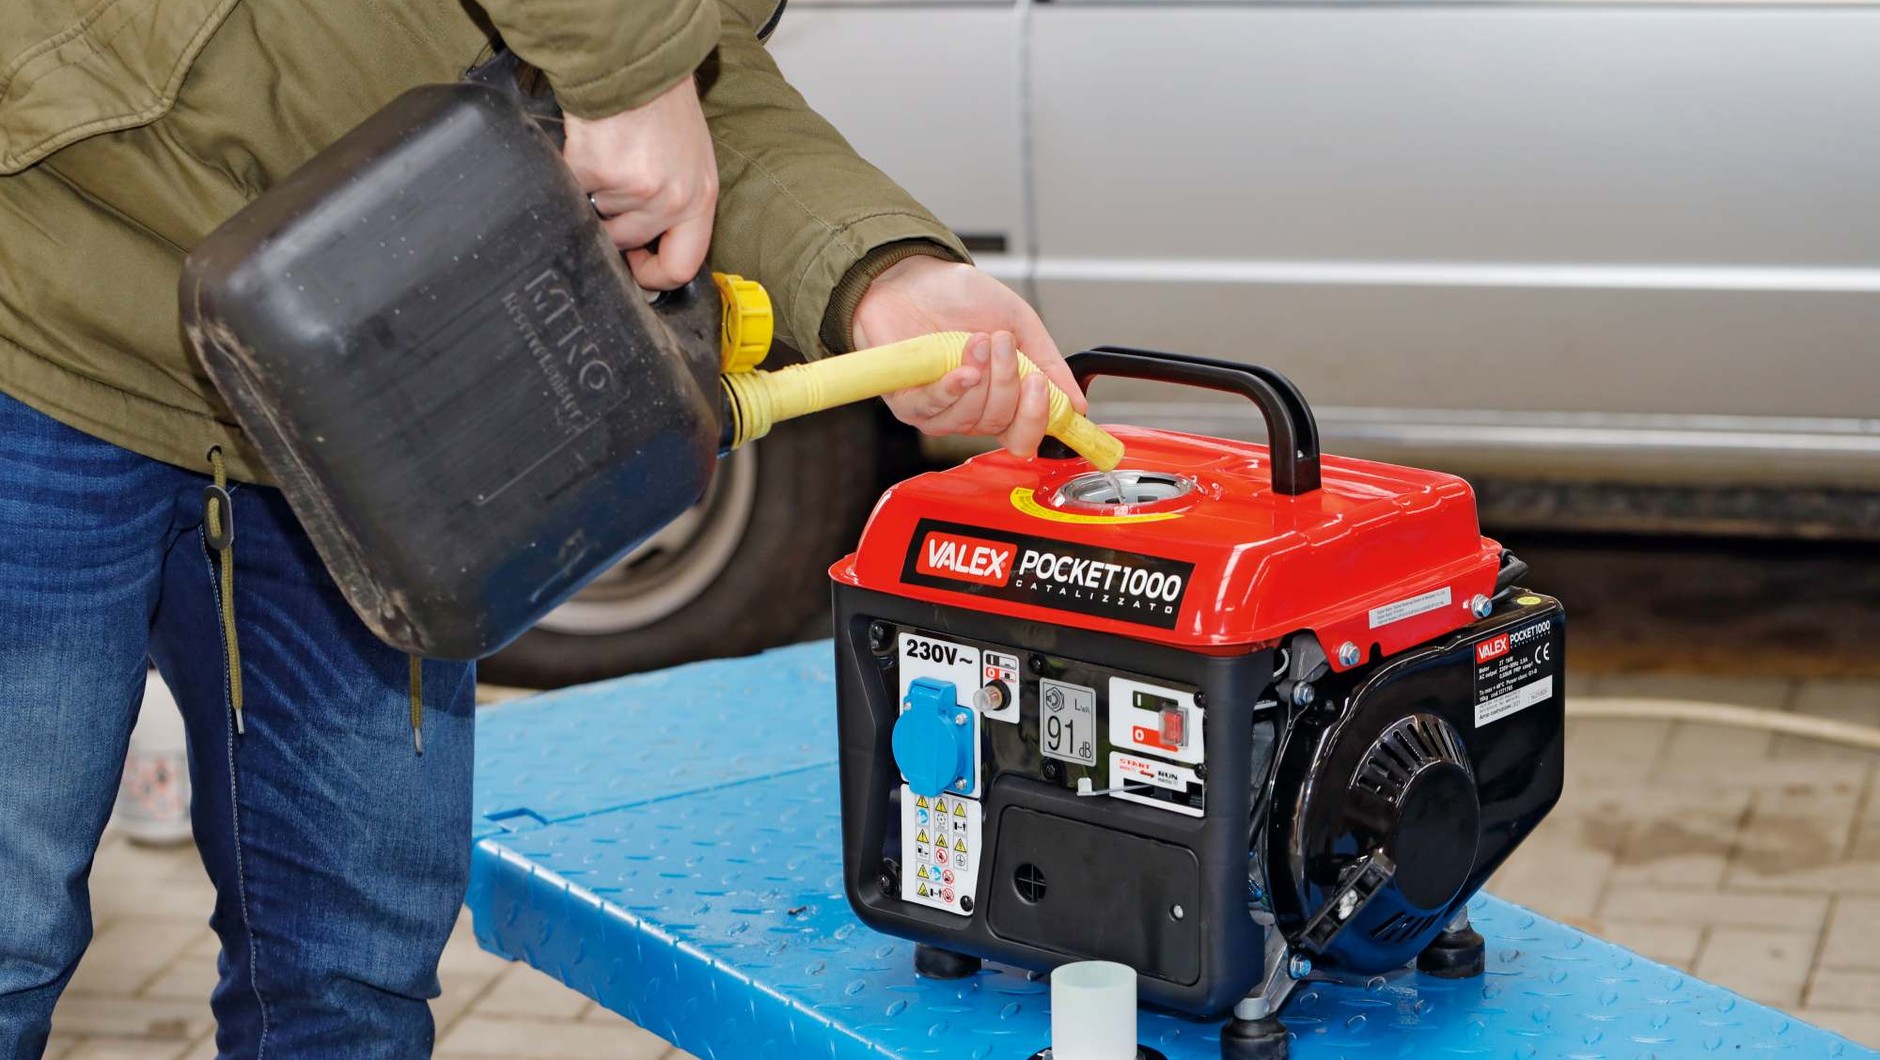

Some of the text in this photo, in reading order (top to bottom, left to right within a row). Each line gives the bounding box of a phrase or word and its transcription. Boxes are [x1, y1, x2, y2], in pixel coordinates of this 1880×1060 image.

[928, 538, 1182, 602] VALEX POCKET1000
[1015, 579, 1173, 614] CATALIZZATO
[1478, 620, 1551, 659] VALEX POCKET1000
[1047, 715, 1074, 754] 91
[1079, 741, 1092, 759] dB
[1158, 770, 1178, 781] RUN
